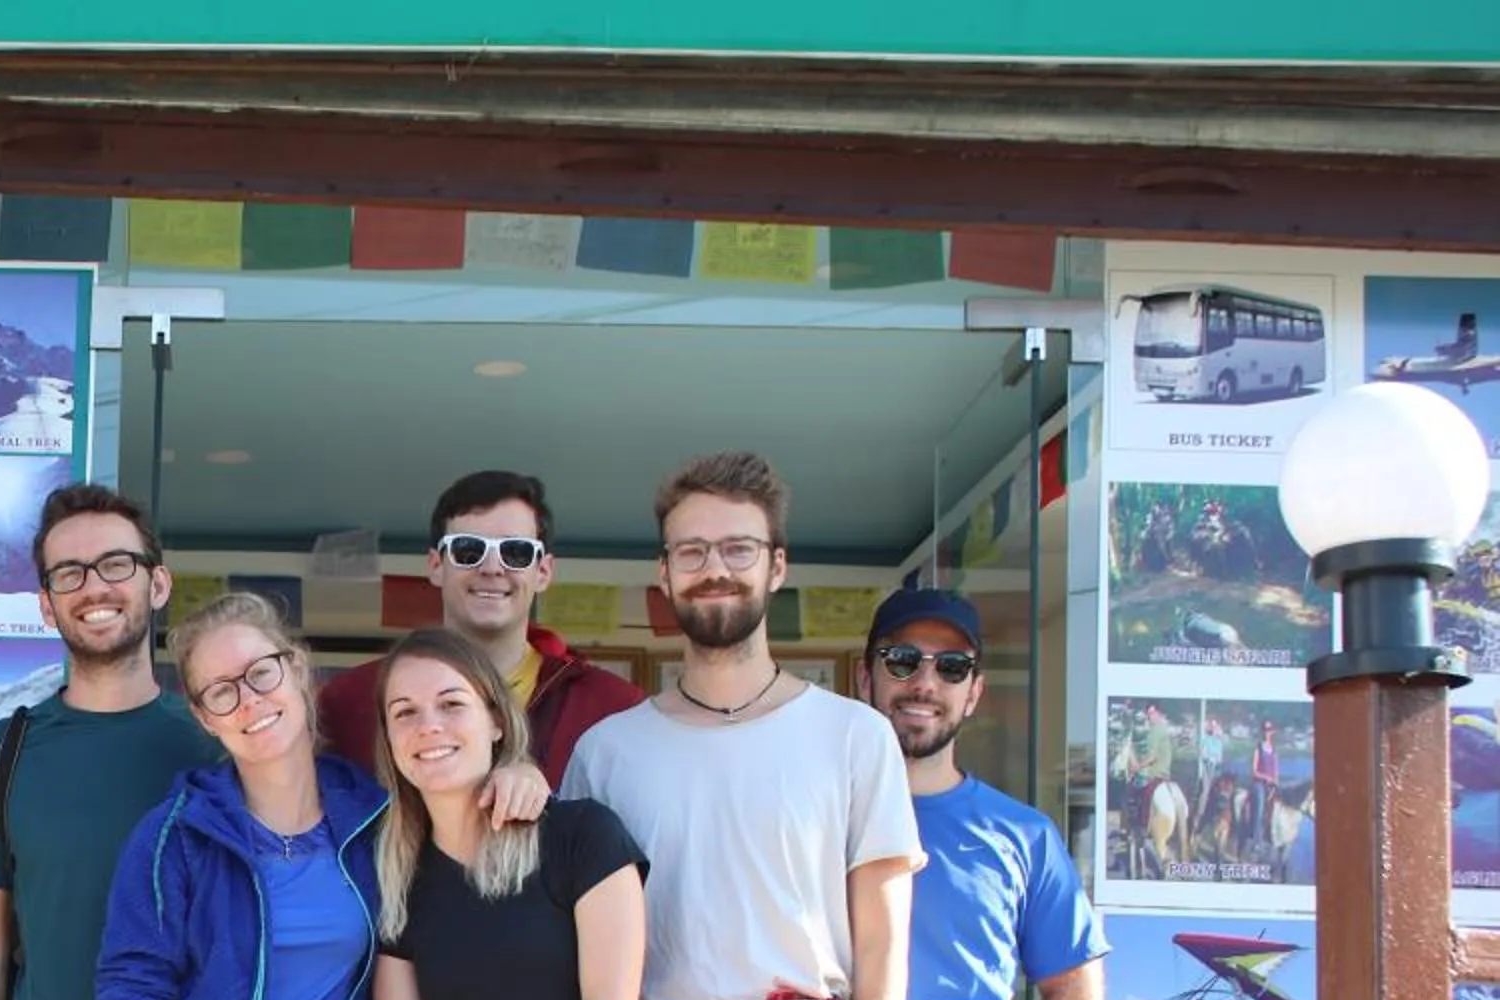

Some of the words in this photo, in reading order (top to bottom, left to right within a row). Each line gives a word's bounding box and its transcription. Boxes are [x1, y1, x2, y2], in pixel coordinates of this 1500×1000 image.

[26, 437, 62, 449] TREK
[1168, 433, 1202, 447] BUS
[1207, 433, 1274, 448] TICKET
[9, 623, 45, 635] TREK
[1168, 863, 1217, 879] PONY
[1219, 864, 1272, 881] TREK
